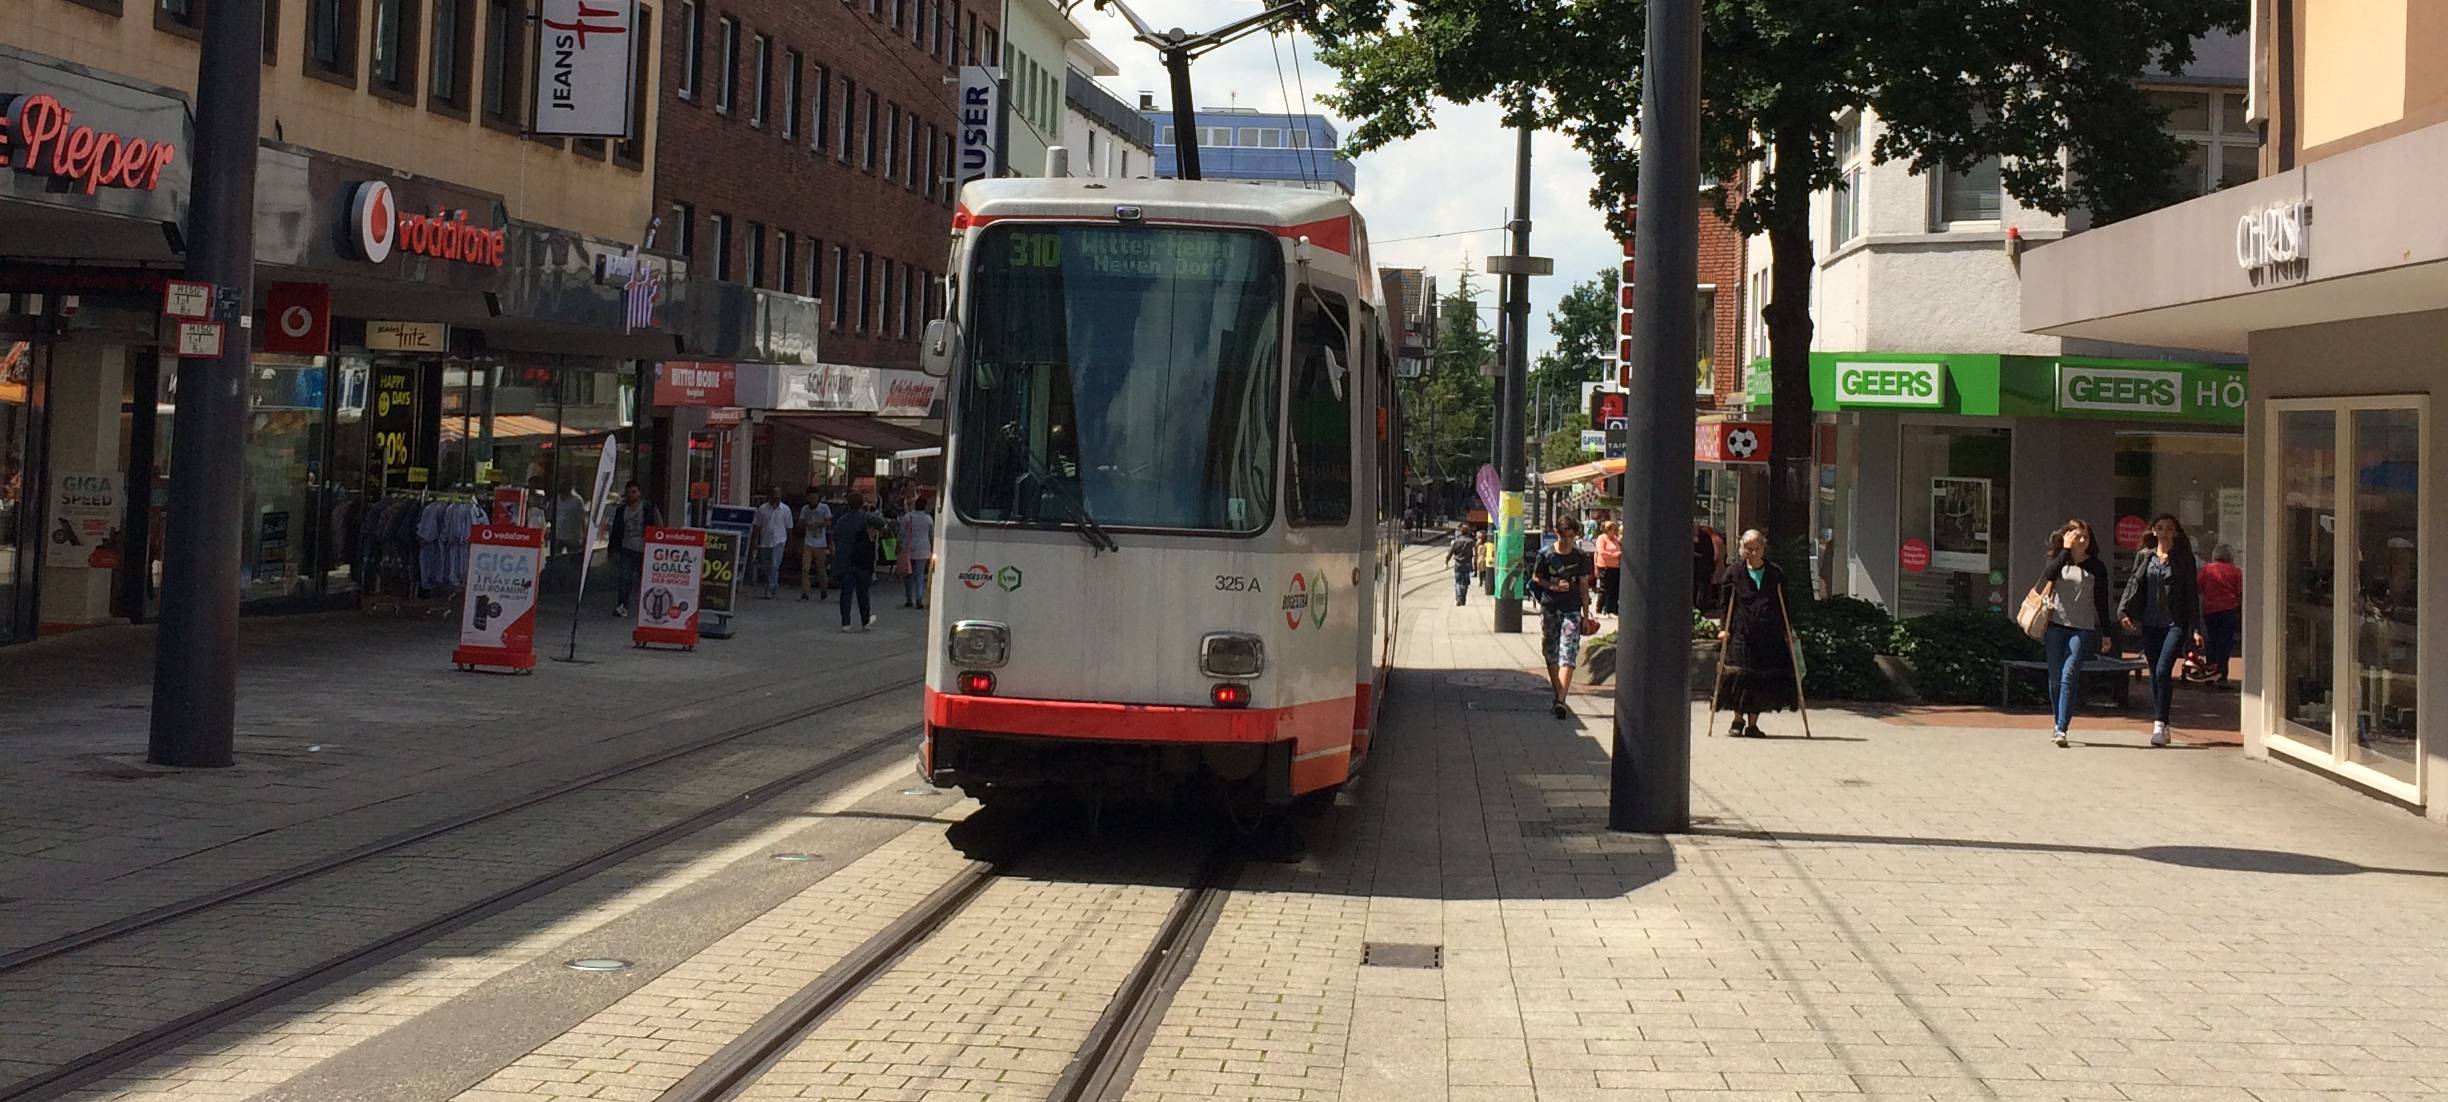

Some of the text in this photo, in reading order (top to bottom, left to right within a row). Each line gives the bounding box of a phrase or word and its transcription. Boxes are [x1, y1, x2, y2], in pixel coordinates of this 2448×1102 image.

[552, 35, 575, 111] JEANS
[20, 94, 175, 196] Pieper
[398, 206, 505, 268] vodafone
[1008, 233, 1061, 267] 310
[381, 375, 406, 389] HAPPY
[1842, 369, 1933, 398] GEERS
[392, 391, 411, 405] DAYS
[2068, 375, 2176, 406] GEERS
[62, 476, 112, 491] GIGA
[62, 495, 113, 506] SPEED
[494, 532, 531, 541] vodafone
[665, 533, 697, 542] vodafone
[476, 552, 529, 575] GIGA
[653, 548, 692, 563] GIGA
[652, 562, 692, 574] GOALS
[1215, 574, 1261, 592] 325 A
